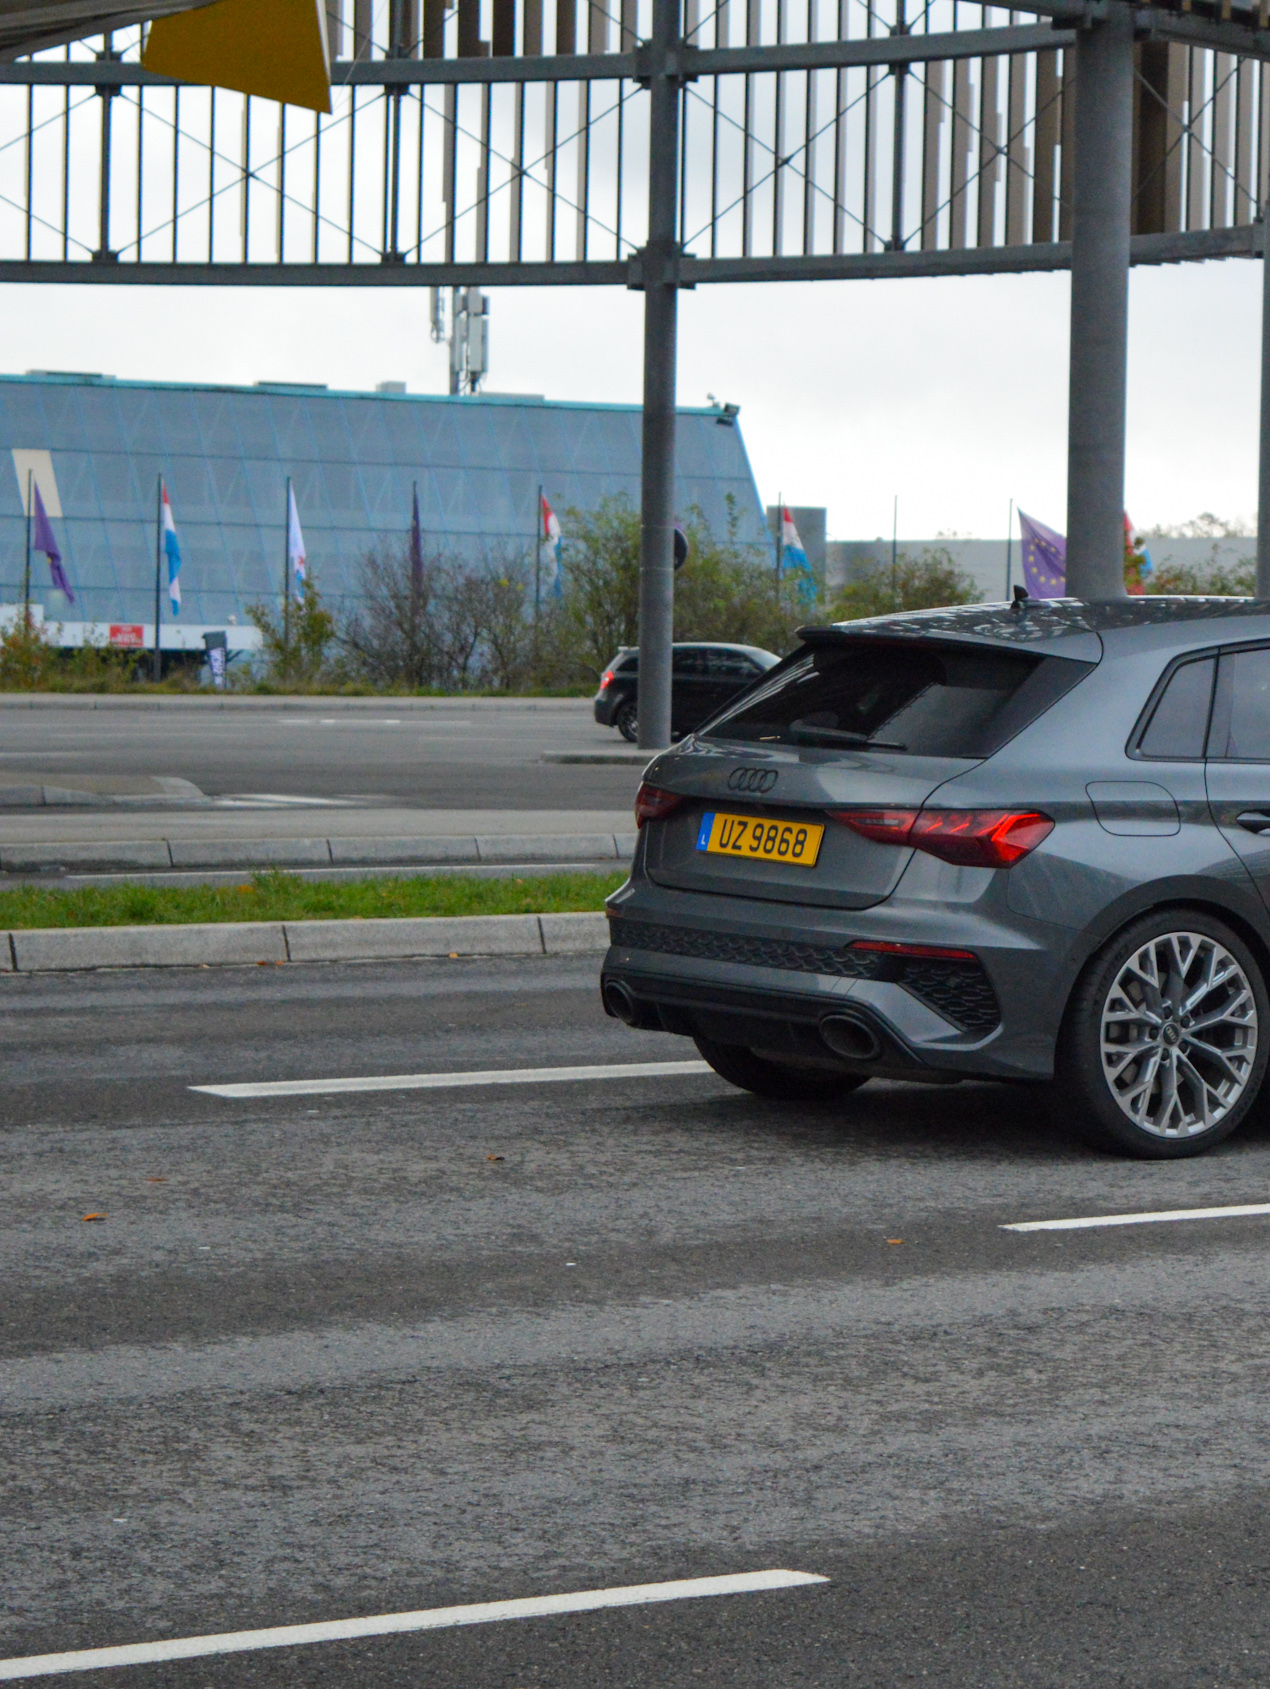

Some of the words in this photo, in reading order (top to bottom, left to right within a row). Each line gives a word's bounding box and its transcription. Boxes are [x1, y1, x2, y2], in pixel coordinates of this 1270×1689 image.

[700, 834, 706, 845] L
[719, 818, 749, 850] UZ
[749, 823, 808, 858] 9868
